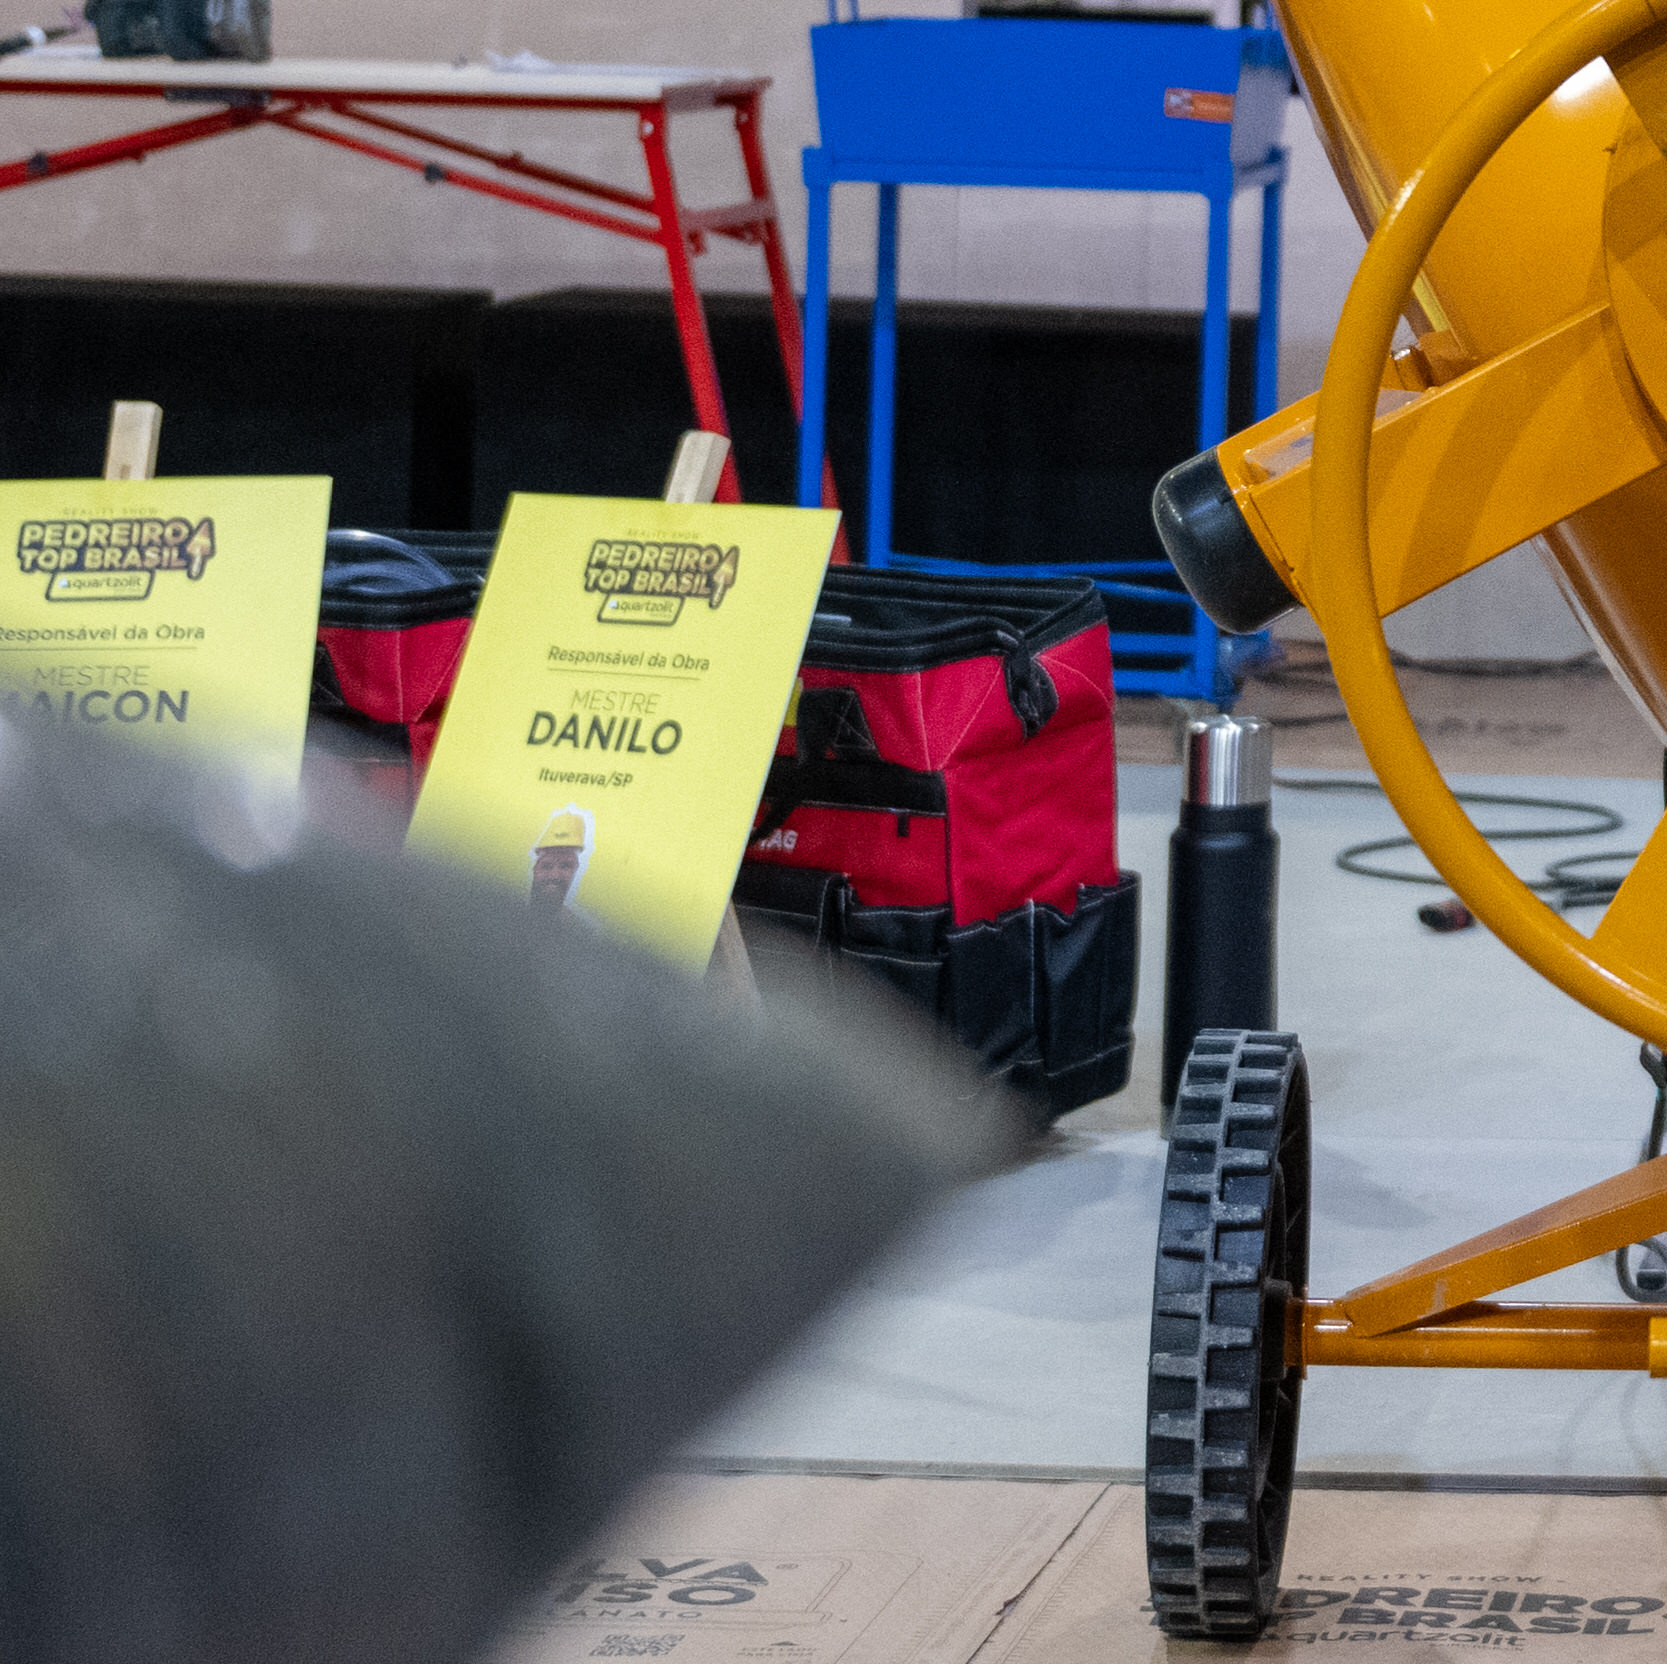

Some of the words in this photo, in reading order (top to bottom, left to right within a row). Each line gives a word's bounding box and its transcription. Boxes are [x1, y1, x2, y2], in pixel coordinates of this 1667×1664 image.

[21, 520, 190, 548] PEDREIRO
[20, 547, 79, 571] TOP
[83, 546, 188, 570] BRASIL
[590, 542, 721, 573] PEDREIRO
[72, 576, 142, 590] quartzolit
[586, 567, 631, 590] TOP
[632, 569, 712, 595] BRASIL
[123, 624, 149, 641] da
[155, 623, 206, 640] Obra
[547, 645, 645, 668] Responsável
[647, 651, 668, 669] da
[671, 653, 711, 671] Obra
[33, 664, 151, 687] MESTRE
[570, 688, 662, 715] MESTRE
[526, 710, 684, 755] DANILO
[538, 767, 634, 788] Ituverava/SP
[568, 1558, 770, 1585] LVA
[1297, 1573, 1432, 1582] REALITY
[1446, 1575, 1542, 1583] SHOW
[1278, 1586, 1665, 1616] DREIRO
[1336, 1607, 1656, 1635] BRASIL
[1286, 1629, 1527, 1646] quartzolit
